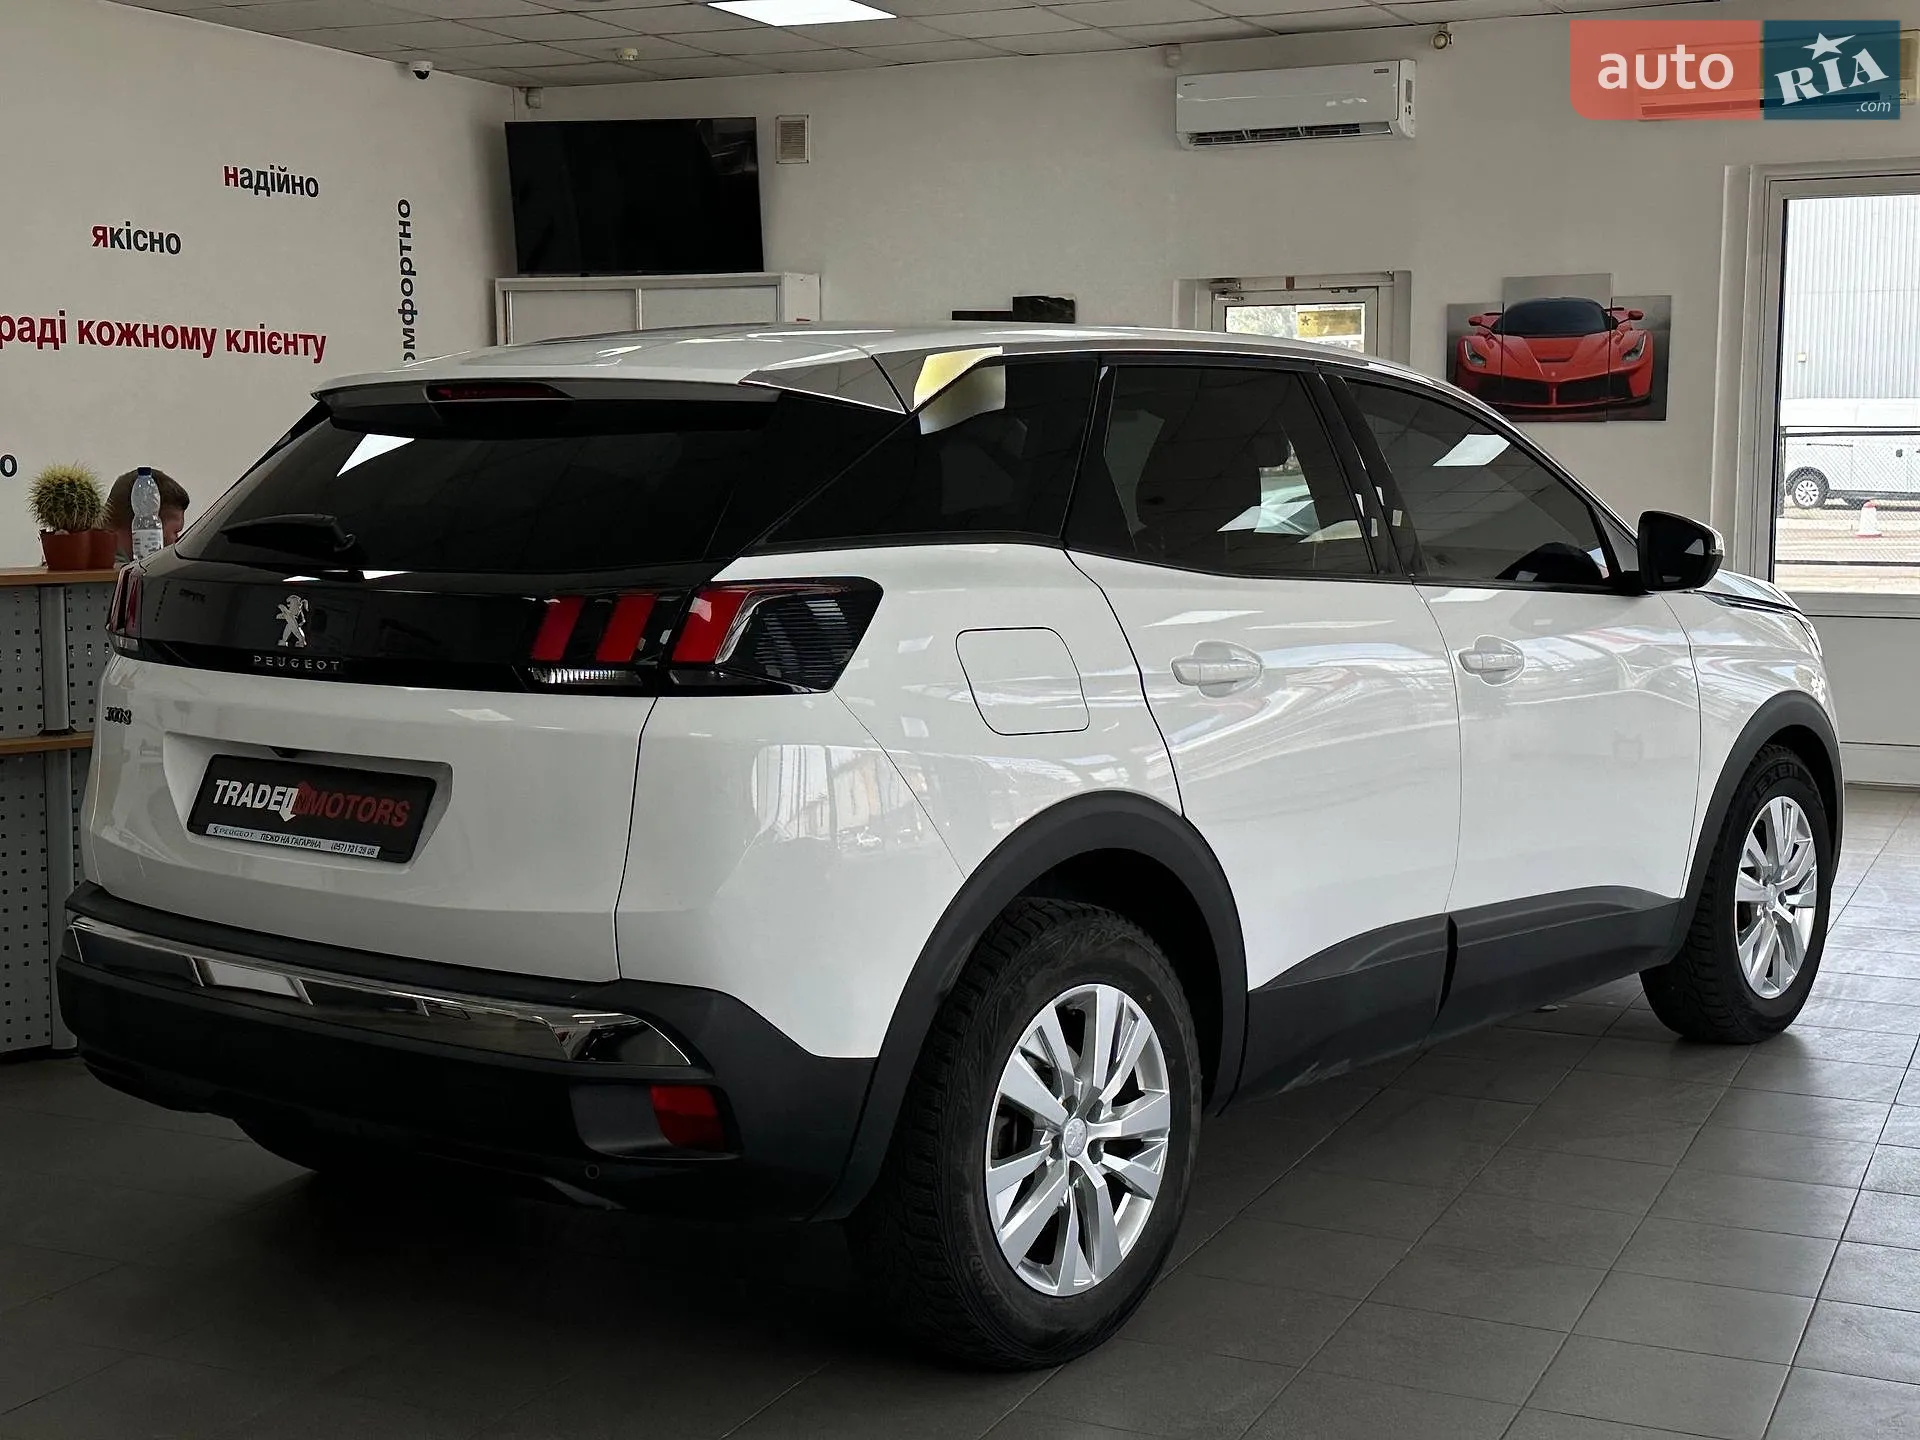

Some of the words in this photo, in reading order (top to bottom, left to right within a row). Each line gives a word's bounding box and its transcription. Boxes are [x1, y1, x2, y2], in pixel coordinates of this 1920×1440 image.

[223, 164, 320, 198] надійно
[91, 221, 182, 255] якісно
[77, 319, 217, 359] кожному
[226, 323, 327, 364] клієнту
[253, 655, 340, 670] PEUGEOT
